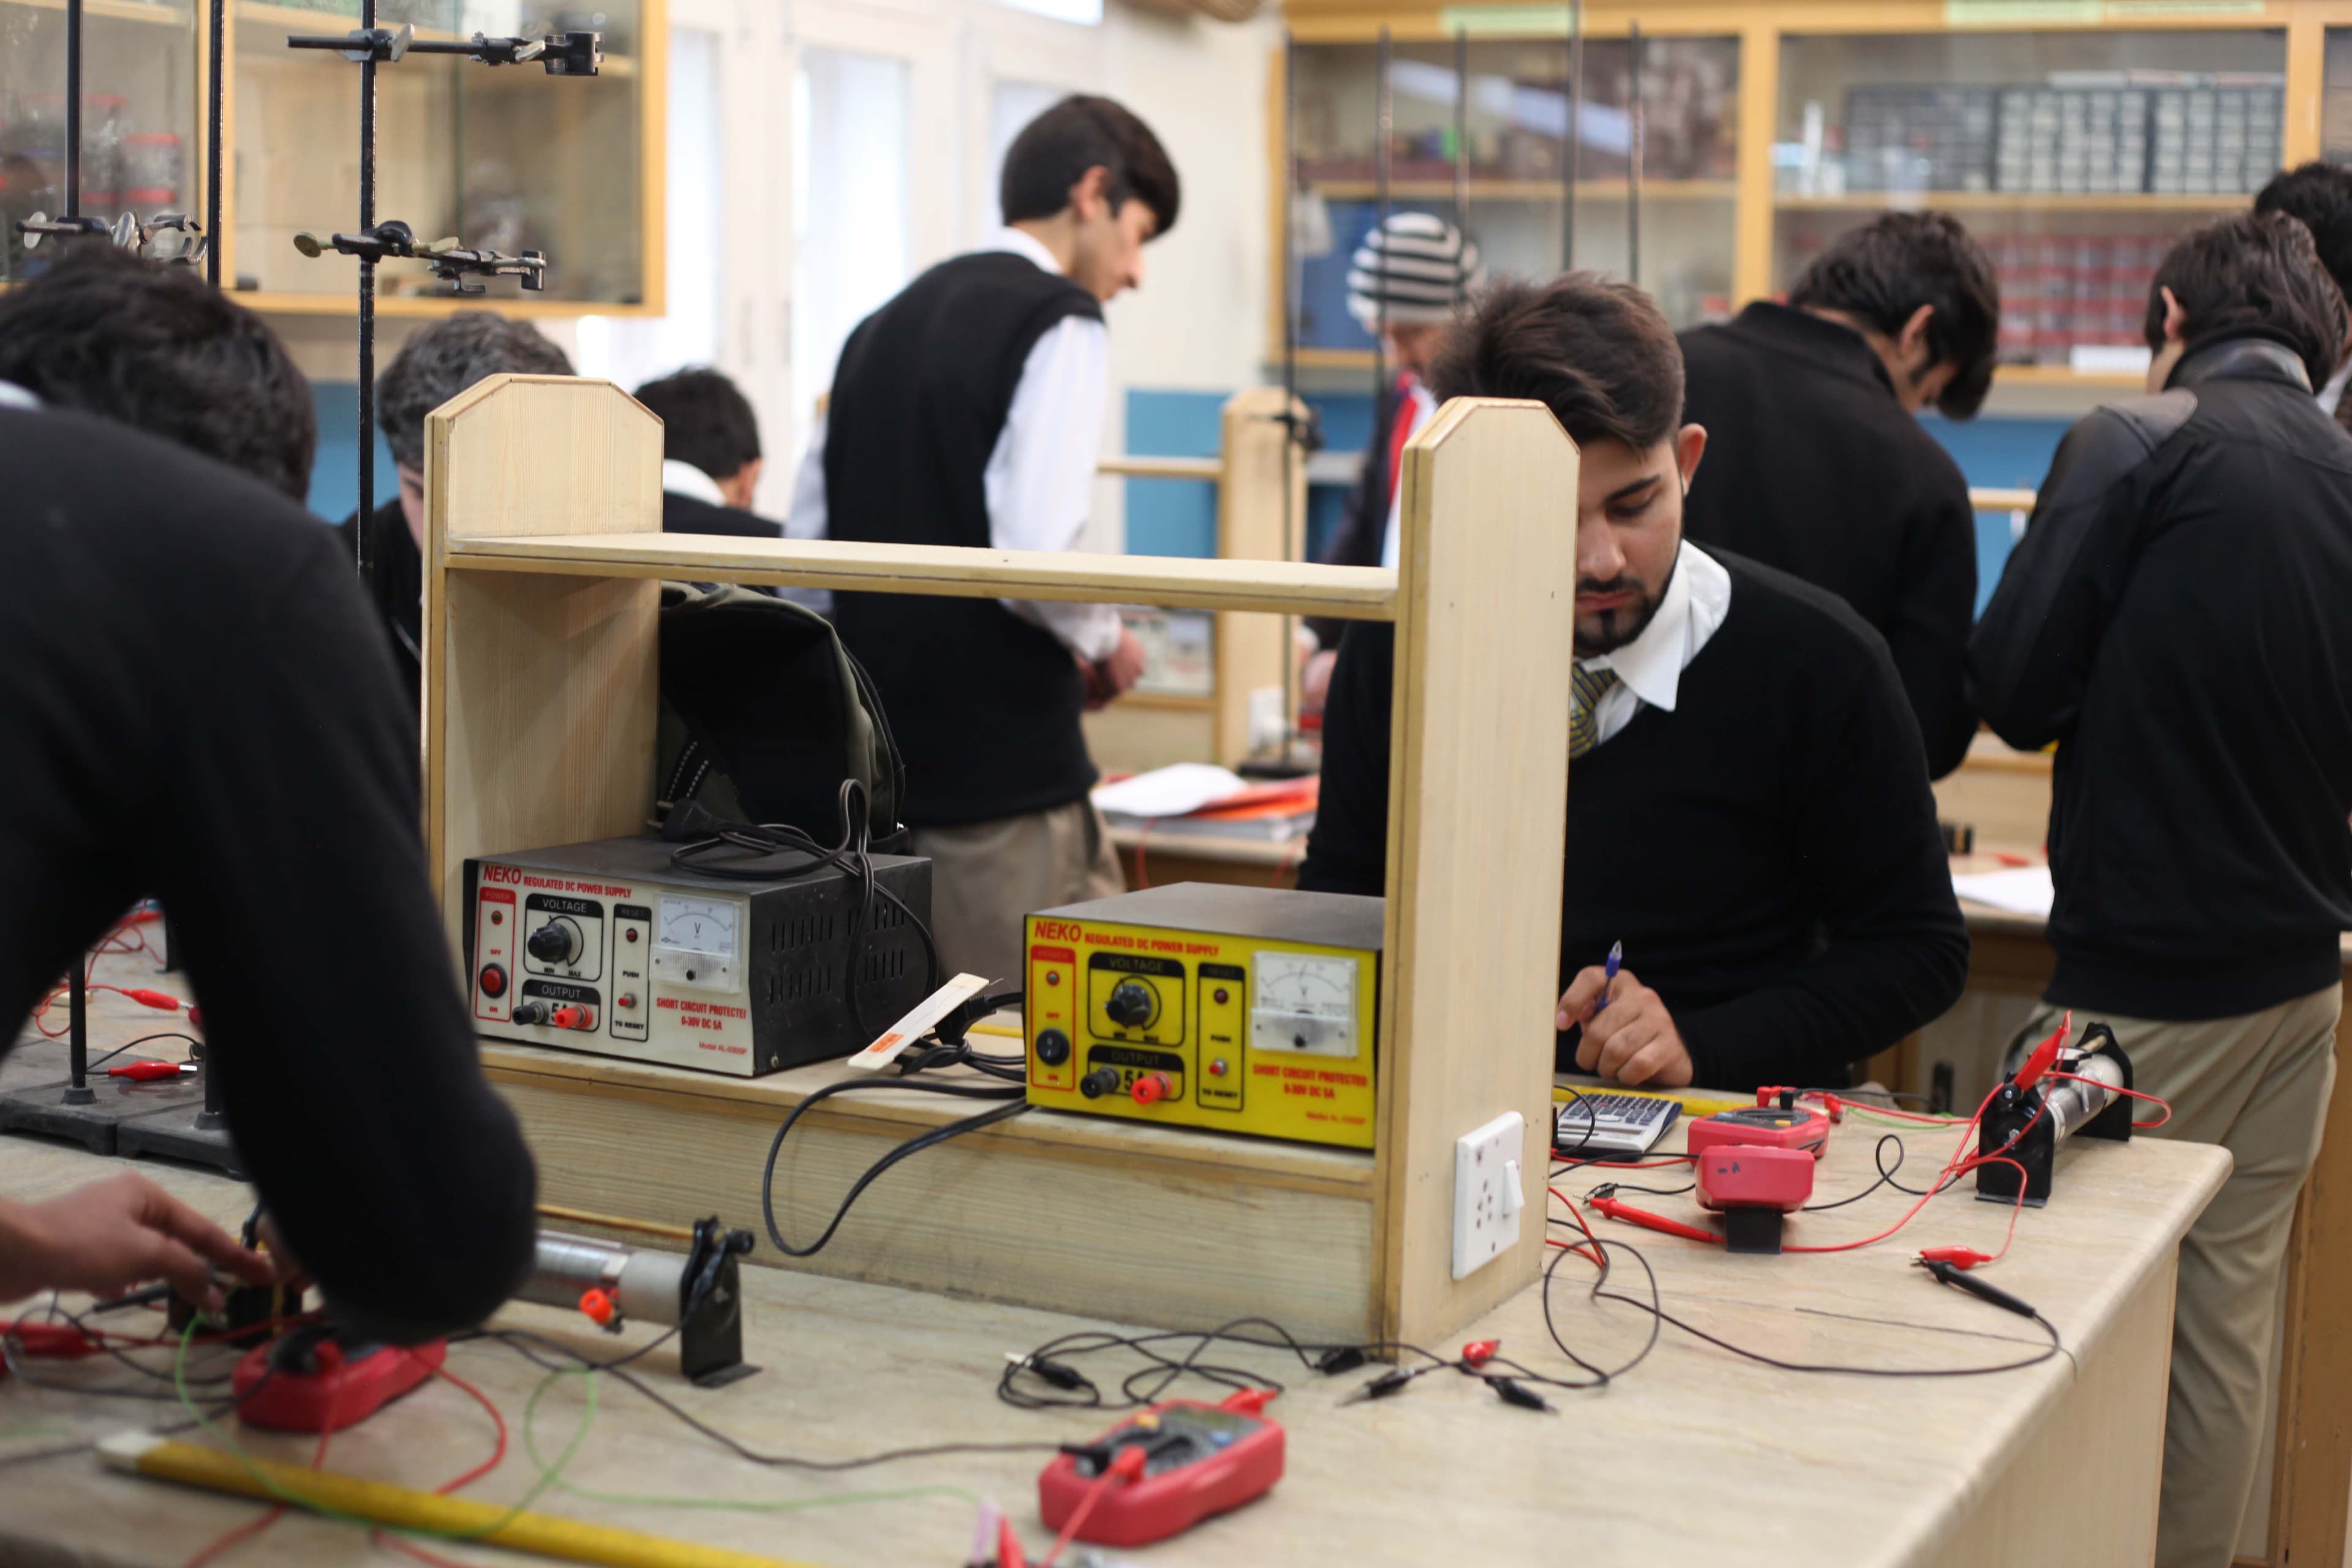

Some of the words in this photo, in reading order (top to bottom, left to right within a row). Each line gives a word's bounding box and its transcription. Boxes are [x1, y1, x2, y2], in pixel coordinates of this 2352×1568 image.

[483, 864, 522, 884] NEKO
[524, 876, 564, 891] REGULATED
[565, 881, 575, 891] DC
[577, 883, 603, 895] POWER
[605, 886, 631, 899] SUPPLY
[543, 898, 587, 913] VOLTAGE
[694, 922, 701, 934] V
[1035, 921, 1082, 942] NEKO
[1085, 933, 1134, 948] REGULATED
[1152, 940, 1183, 953] POWER
[1186, 943, 1219, 957] SUPPLY
[542, 985, 581, 998] OUTPUT
[657, 997, 679, 1010] SHORT
[680, 1000, 707, 1013] CIRCUIT
[624, 1021, 644, 1030] RESET
[681, 1016, 700, 1027] 0-30V
[702, 1018, 711, 1029] DC
[713, 1019, 723, 1030] 5A
[699, 1041, 717, 1051] Model
[1112, 1049, 1159, 1065] OUTPUT
